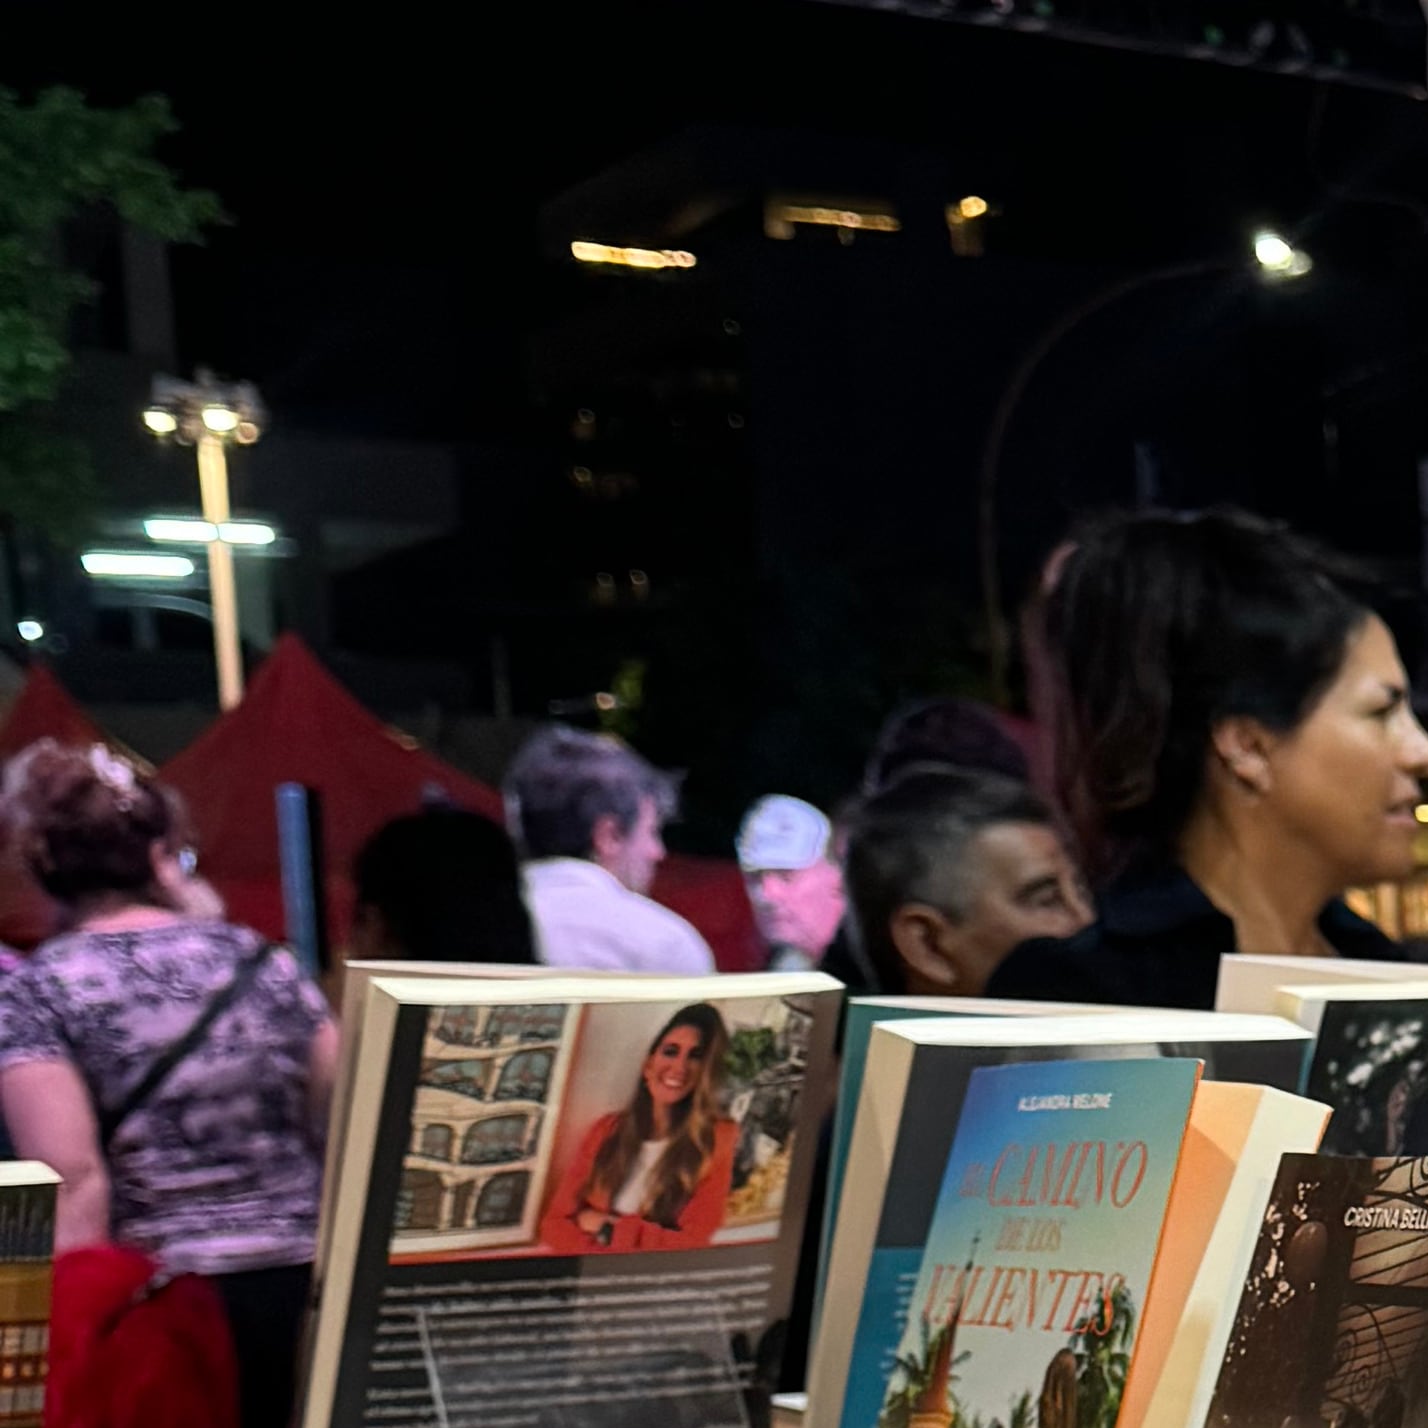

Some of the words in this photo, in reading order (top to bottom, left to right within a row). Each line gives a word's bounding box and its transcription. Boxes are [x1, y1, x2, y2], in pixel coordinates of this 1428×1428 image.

[987, 1140, 1149, 1209] CAMINO
[1344, 1206, 1400, 1229] CRISTINA
[922, 1264, 1125, 1336] VALIENTES
